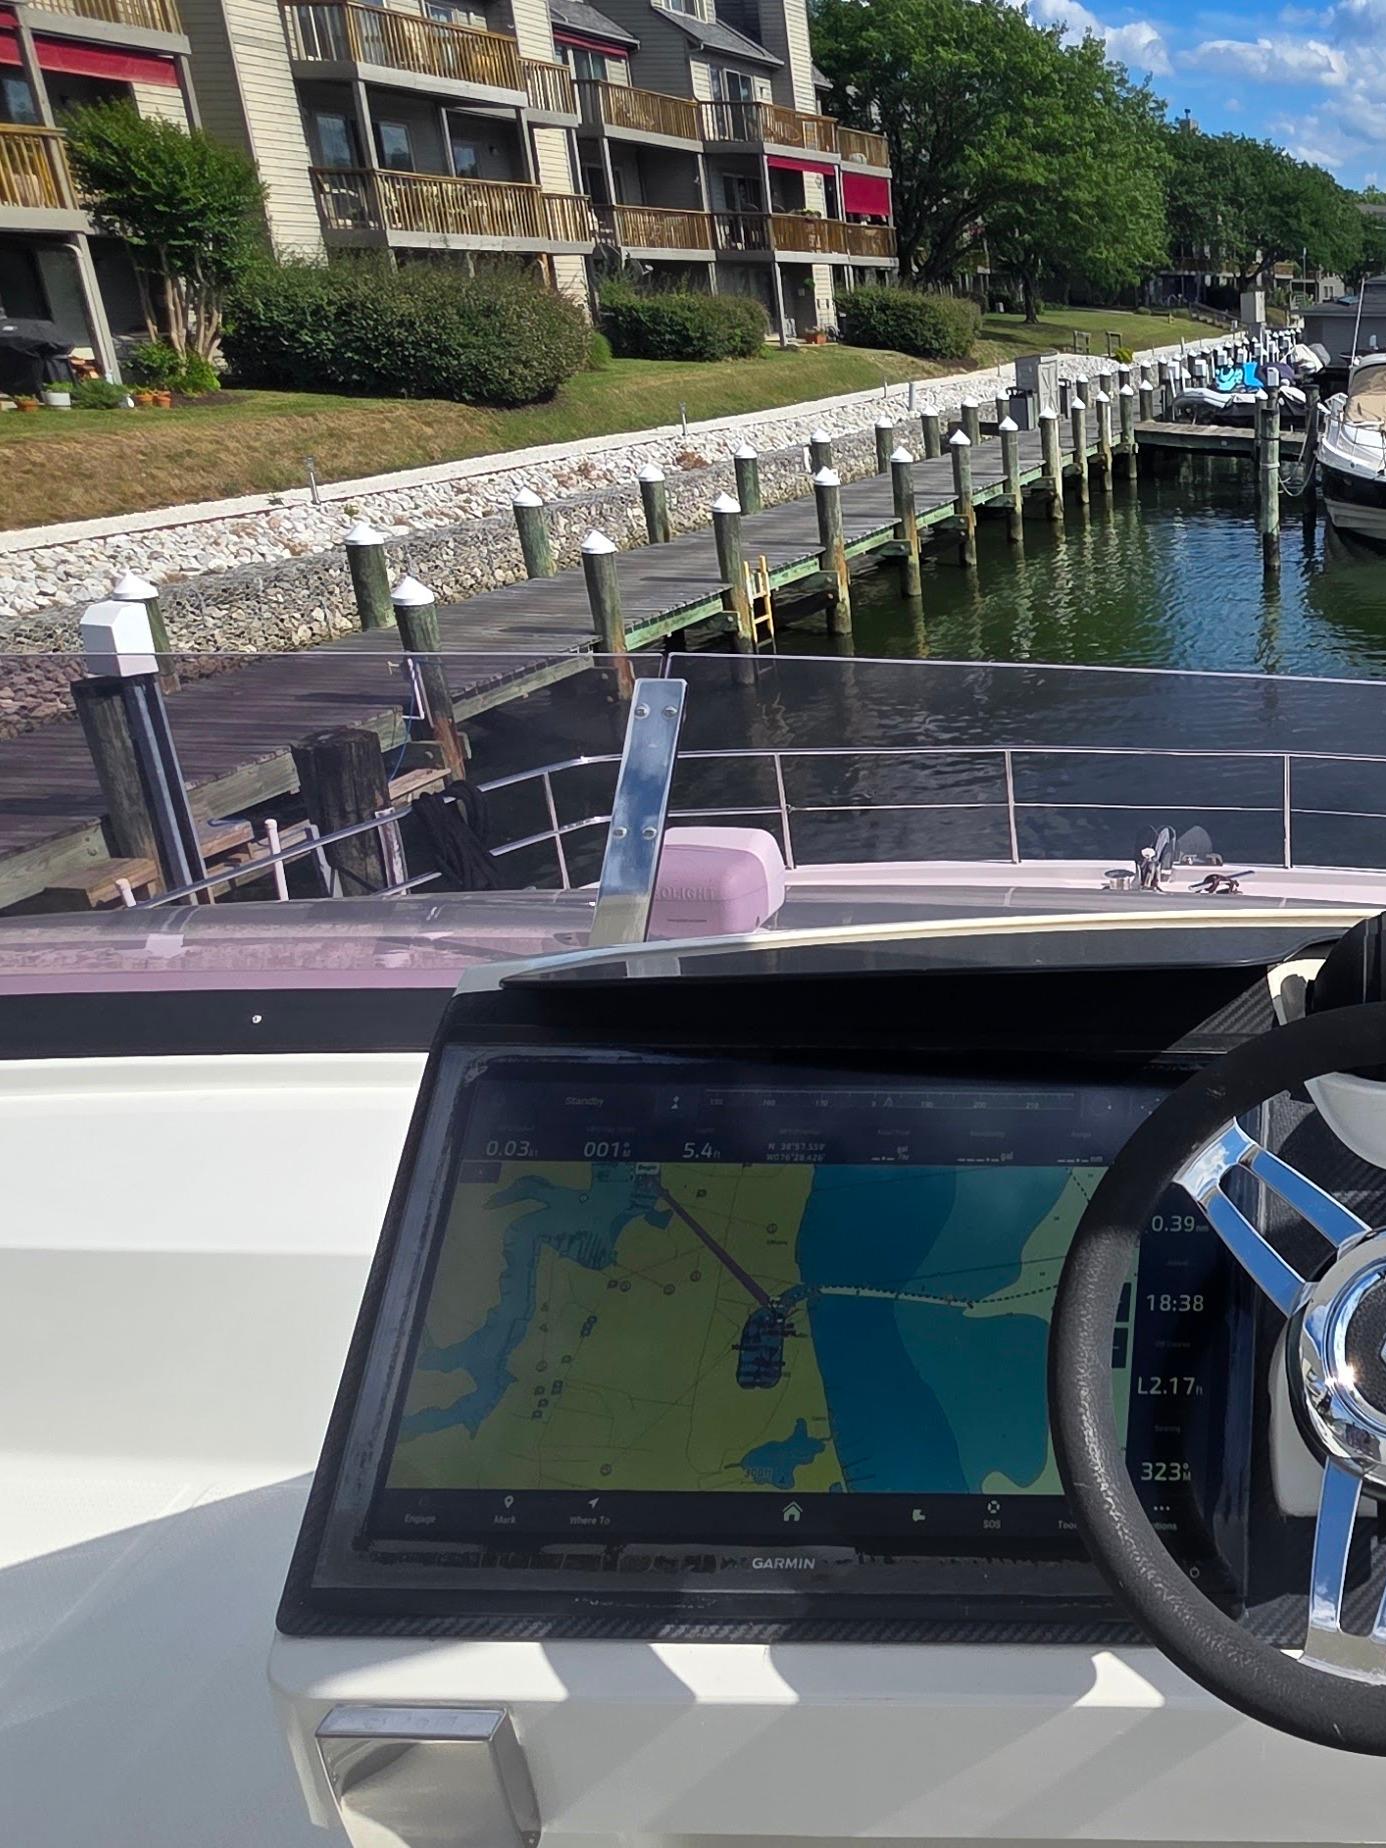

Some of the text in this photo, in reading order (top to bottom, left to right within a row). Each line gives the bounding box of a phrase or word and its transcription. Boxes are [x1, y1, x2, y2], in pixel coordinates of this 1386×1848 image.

[564, 1095, 605, 1107] Standby
[485, 1140, 529, 1157] 0.03
[583, 1141, 620, 1158] 001
[681, 1141, 713, 1159] 5.4
[1151, 1215, 1195, 1232] 0.39
[1146, 1294, 1205, 1313] 18:38
[1137, 1376, 1195, 1396] L2.17
[1140, 1461, 1181, 1481] 323
[983, 1519, 1001, 1530] SOS
[751, 1557, 816, 1571] GARMIN
